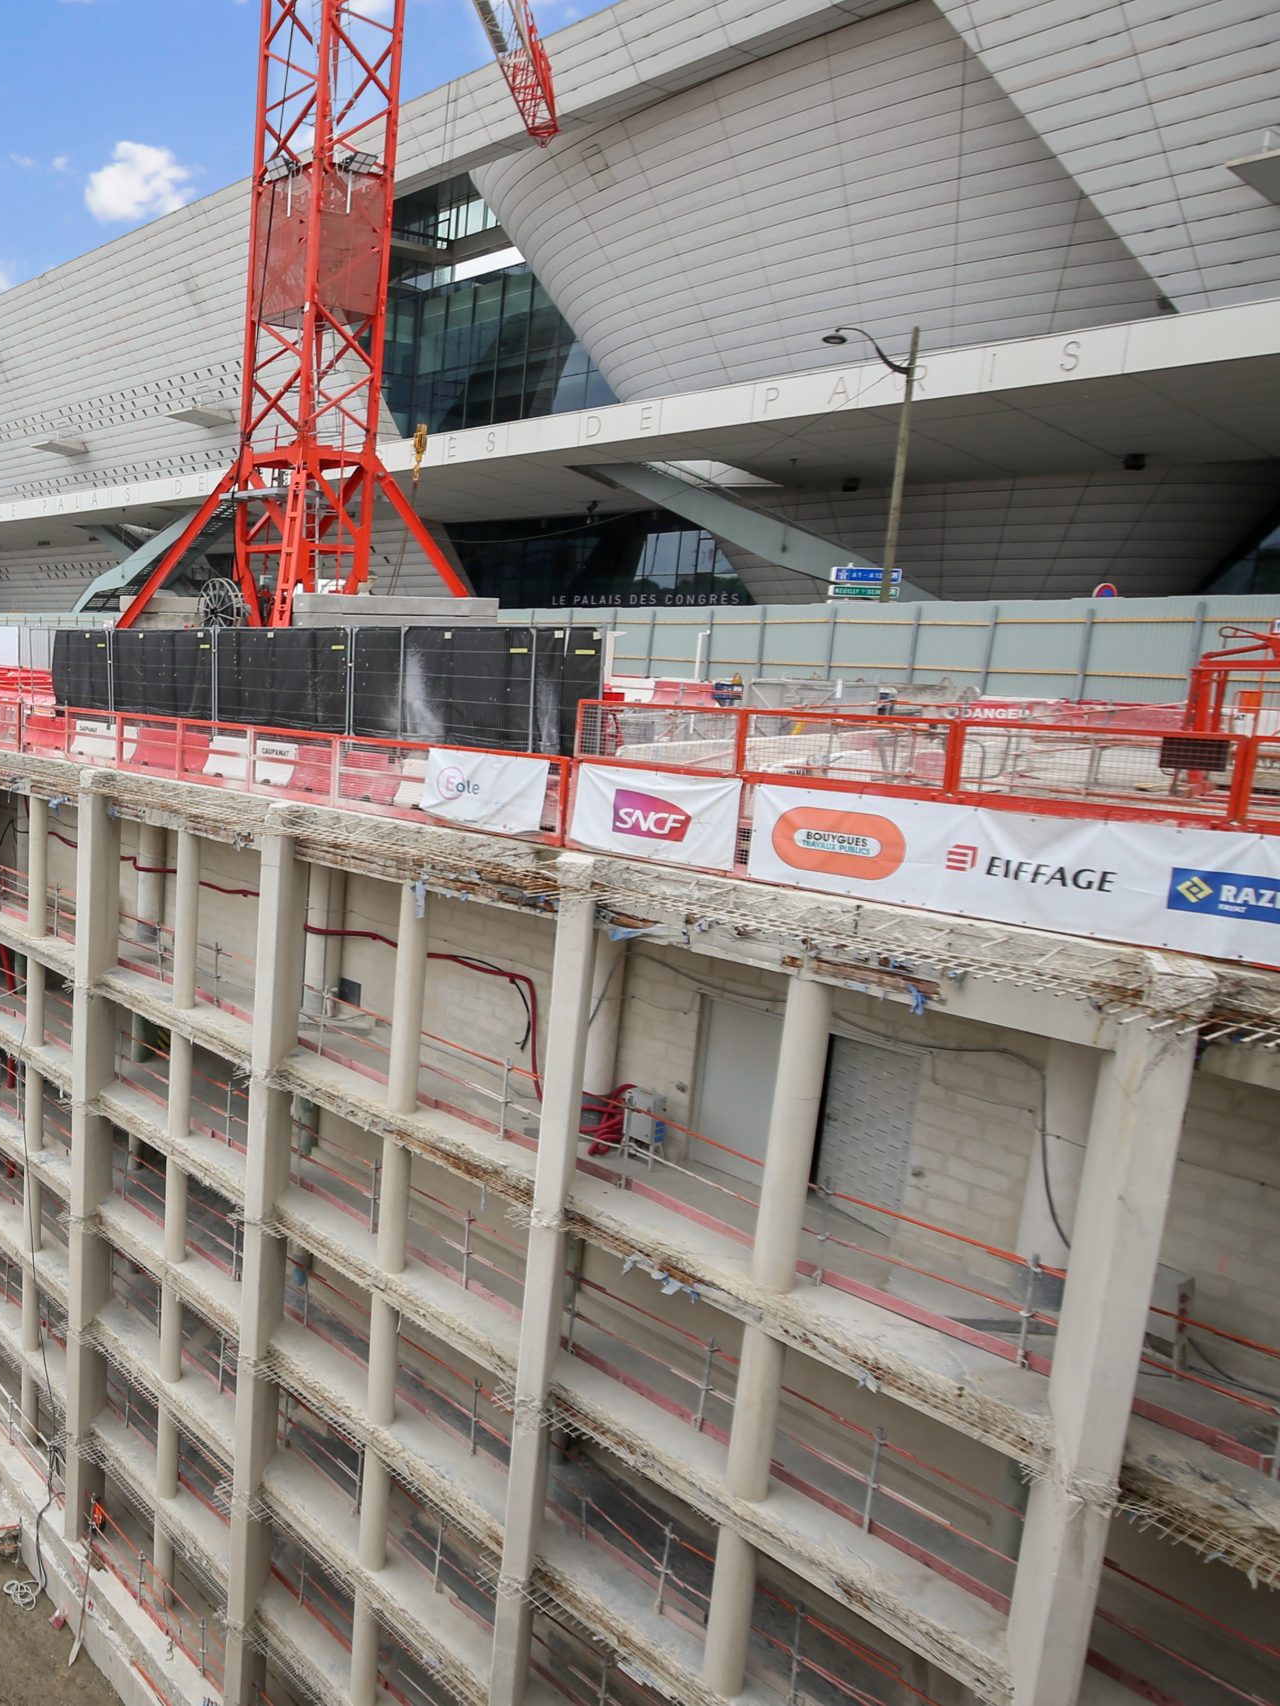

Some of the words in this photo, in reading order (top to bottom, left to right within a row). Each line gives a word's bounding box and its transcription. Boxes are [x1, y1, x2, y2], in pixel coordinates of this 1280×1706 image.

[42, 486, 131, 514] PALAIS
[586, 406, 653, 439] DE
[763, 340, 1081, 414] PARIS
[552, 595, 567, 606] LE
[573, 594, 622, 606] PALAIS
[629, 594, 657, 605] DES
[665, 591, 740, 605] CONGRÈS
[445, 775, 480, 795] Eole
[615, 807, 686, 835] SNCF
[802, 839, 837, 851] TRAVAUX
[839, 844, 871, 856] PUBLICS
[806, 830, 868, 847] BOUYGUES
[985, 855, 1119, 893] EIFFAGE
